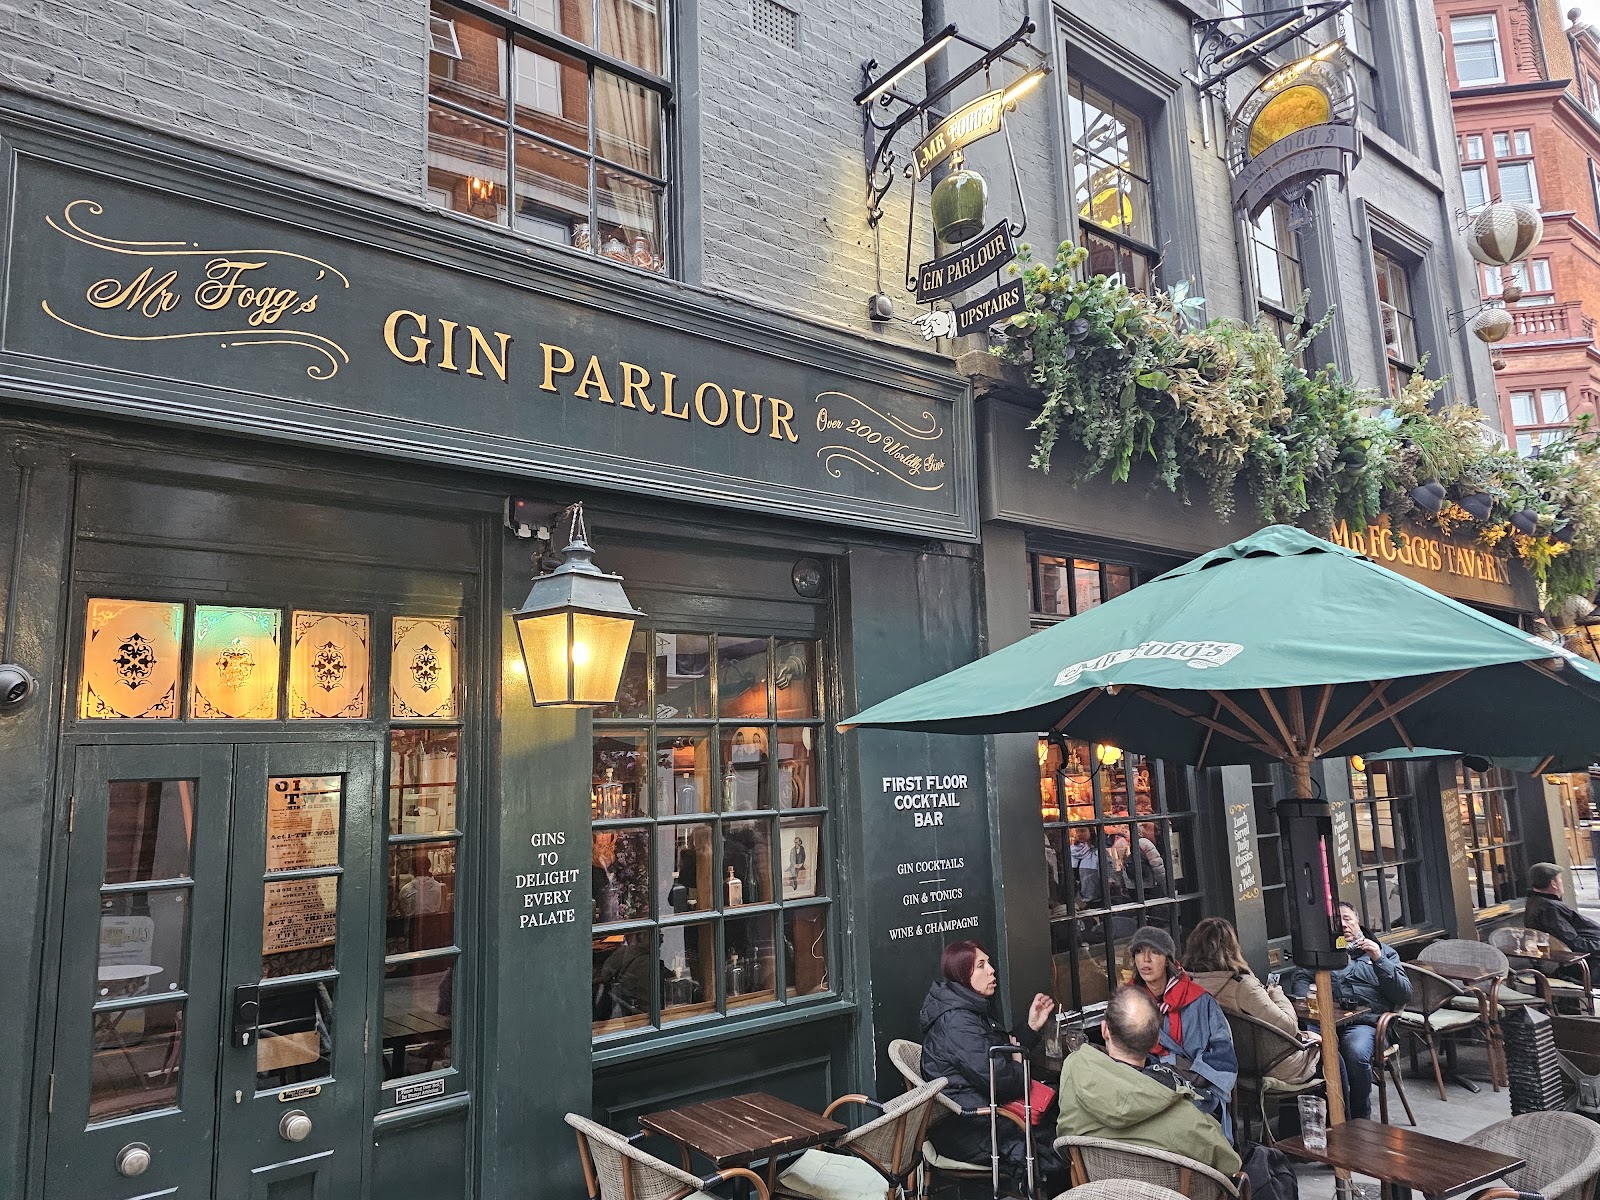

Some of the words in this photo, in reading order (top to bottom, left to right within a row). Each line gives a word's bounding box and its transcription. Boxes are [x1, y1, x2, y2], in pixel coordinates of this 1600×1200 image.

[920, 133, 947, 168] MR
[1241, 157, 1266, 185] MR
[1254, 151, 1326, 194] TAVERN
[922, 269, 944, 292] GIN
[946, 235, 1007, 285] PARLOUR
[86, 266, 182, 318] Mr
[194, 258, 326, 327] Fogg's
[959, 287, 1020, 329] UPSTAIRS
[384, 309, 513, 383] GIN
[538, 342, 799, 443] PARLOUR
[816, 408, 843, 432] Over
[846, 418, 882, 444] 200
[883, 436, 923, 476] Worldly
[1368, 524, 1442, 571] FOGG'S
[1443, 543, 1511, 585] TAVERN
[882, 776, 923, 793] FIRST
[926, 774, 968, 790] FLOOR
[894, 793, 960, 811] COCKTAIL
[914, 811, 944, 828] BAR
[1233, 811, 1249, 829] Lunch
[531, 832, 566, 847] GINS
[1233, 822, 1250, 841] Served
[538, 851, 558, 866] TO
[897, 862, 914, 875] GIN
[915, 857, 964, 873] COCKTAILS
[515, 869, 579, 889] DELIGHT
[1240, 862, 1252, 878] with
[523, 889, 572, 908] EVERY
[902, 893, 920, 906] GIN
[920, 892, 928, 904] &
[930, 888, 963, 902] TONICS
[519, 908, 575, 929] PALATE
[889, 926, 914, 941] WINE
[915, 924, 923, 936] &
[924, 916, 979, 935] CHAMPAGNE
